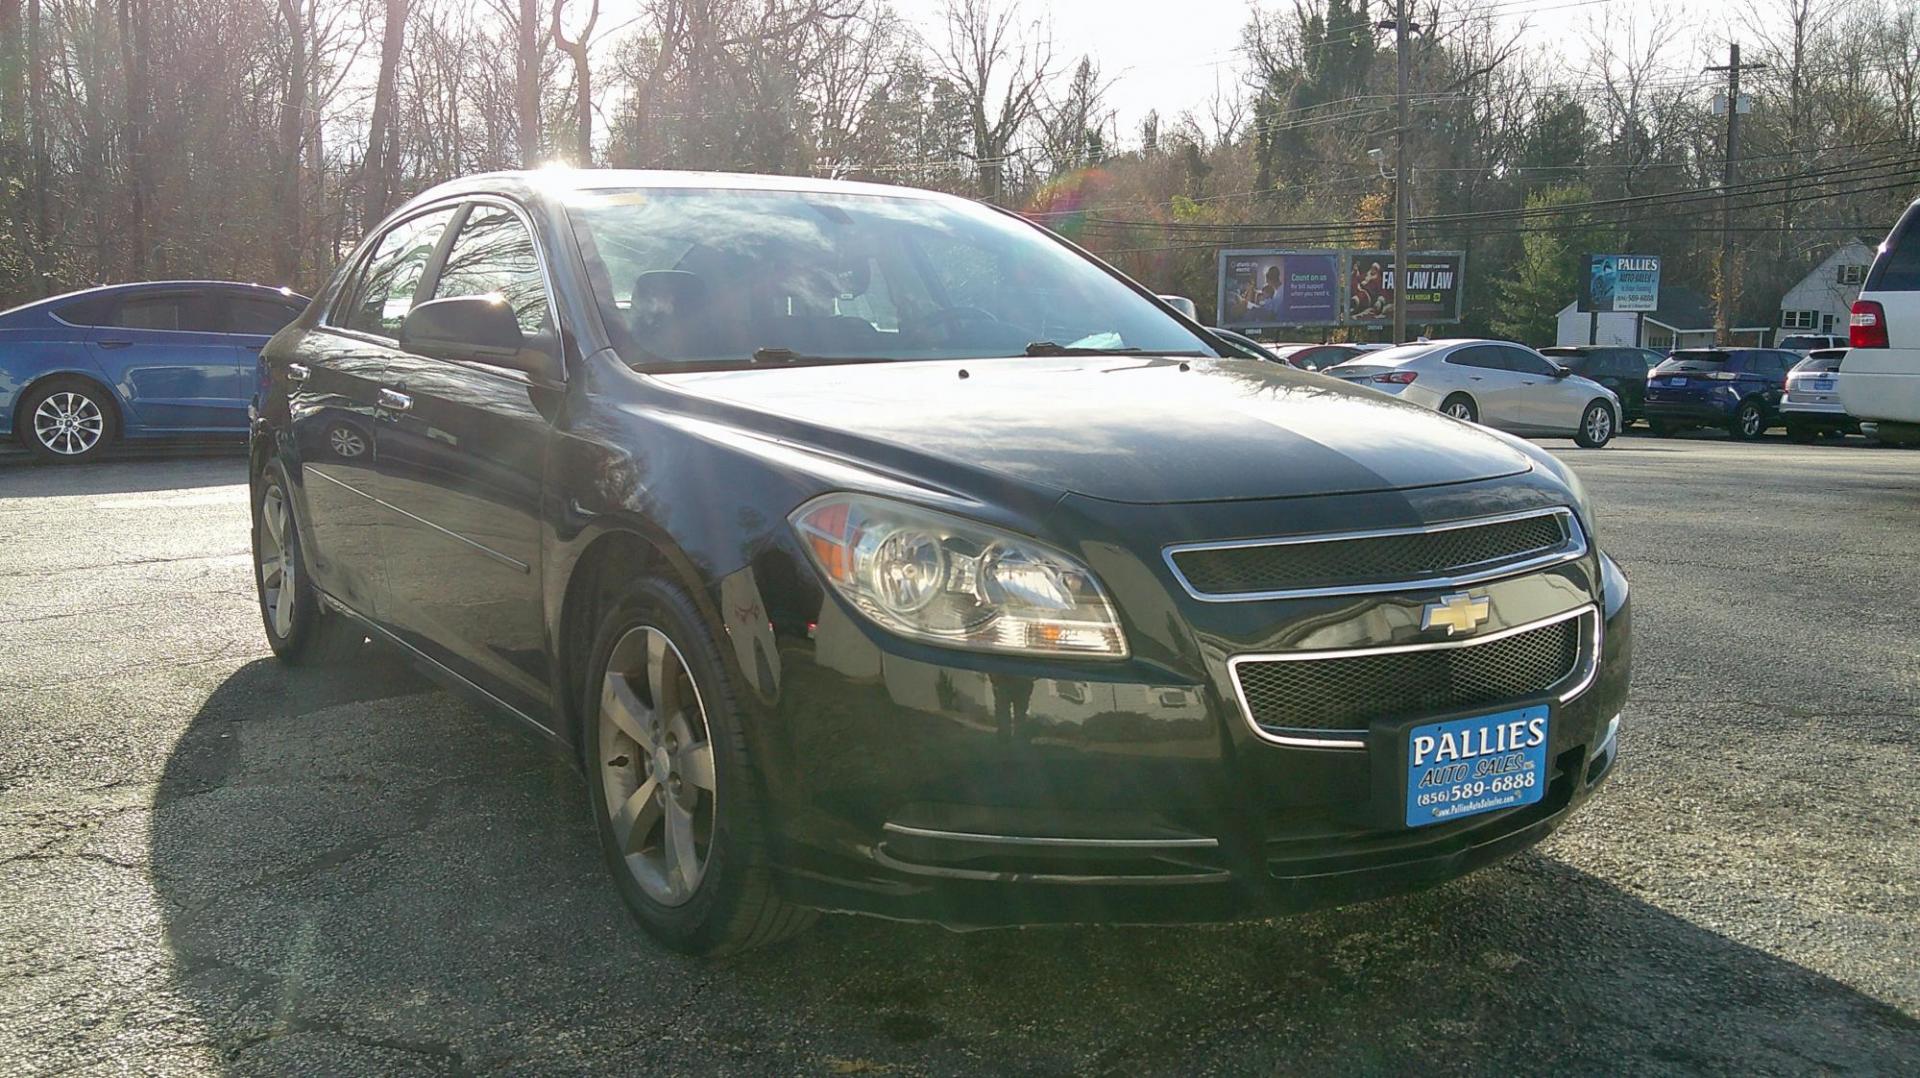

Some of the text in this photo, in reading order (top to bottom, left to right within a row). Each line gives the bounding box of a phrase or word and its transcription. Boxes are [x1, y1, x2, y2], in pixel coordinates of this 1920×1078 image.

[1618, 258, 1658, 271] PALLIES
[1291, 273, 1310, 282] Count
[1407, 271, 1429, 290] LAW
[1430, 271, 1453, 290] LAW
[1413, 717, 1546, 766] PALLIES
[1418, 763, 1469, 788] AUTO
[1472, 752, 1525, 779] SALES
